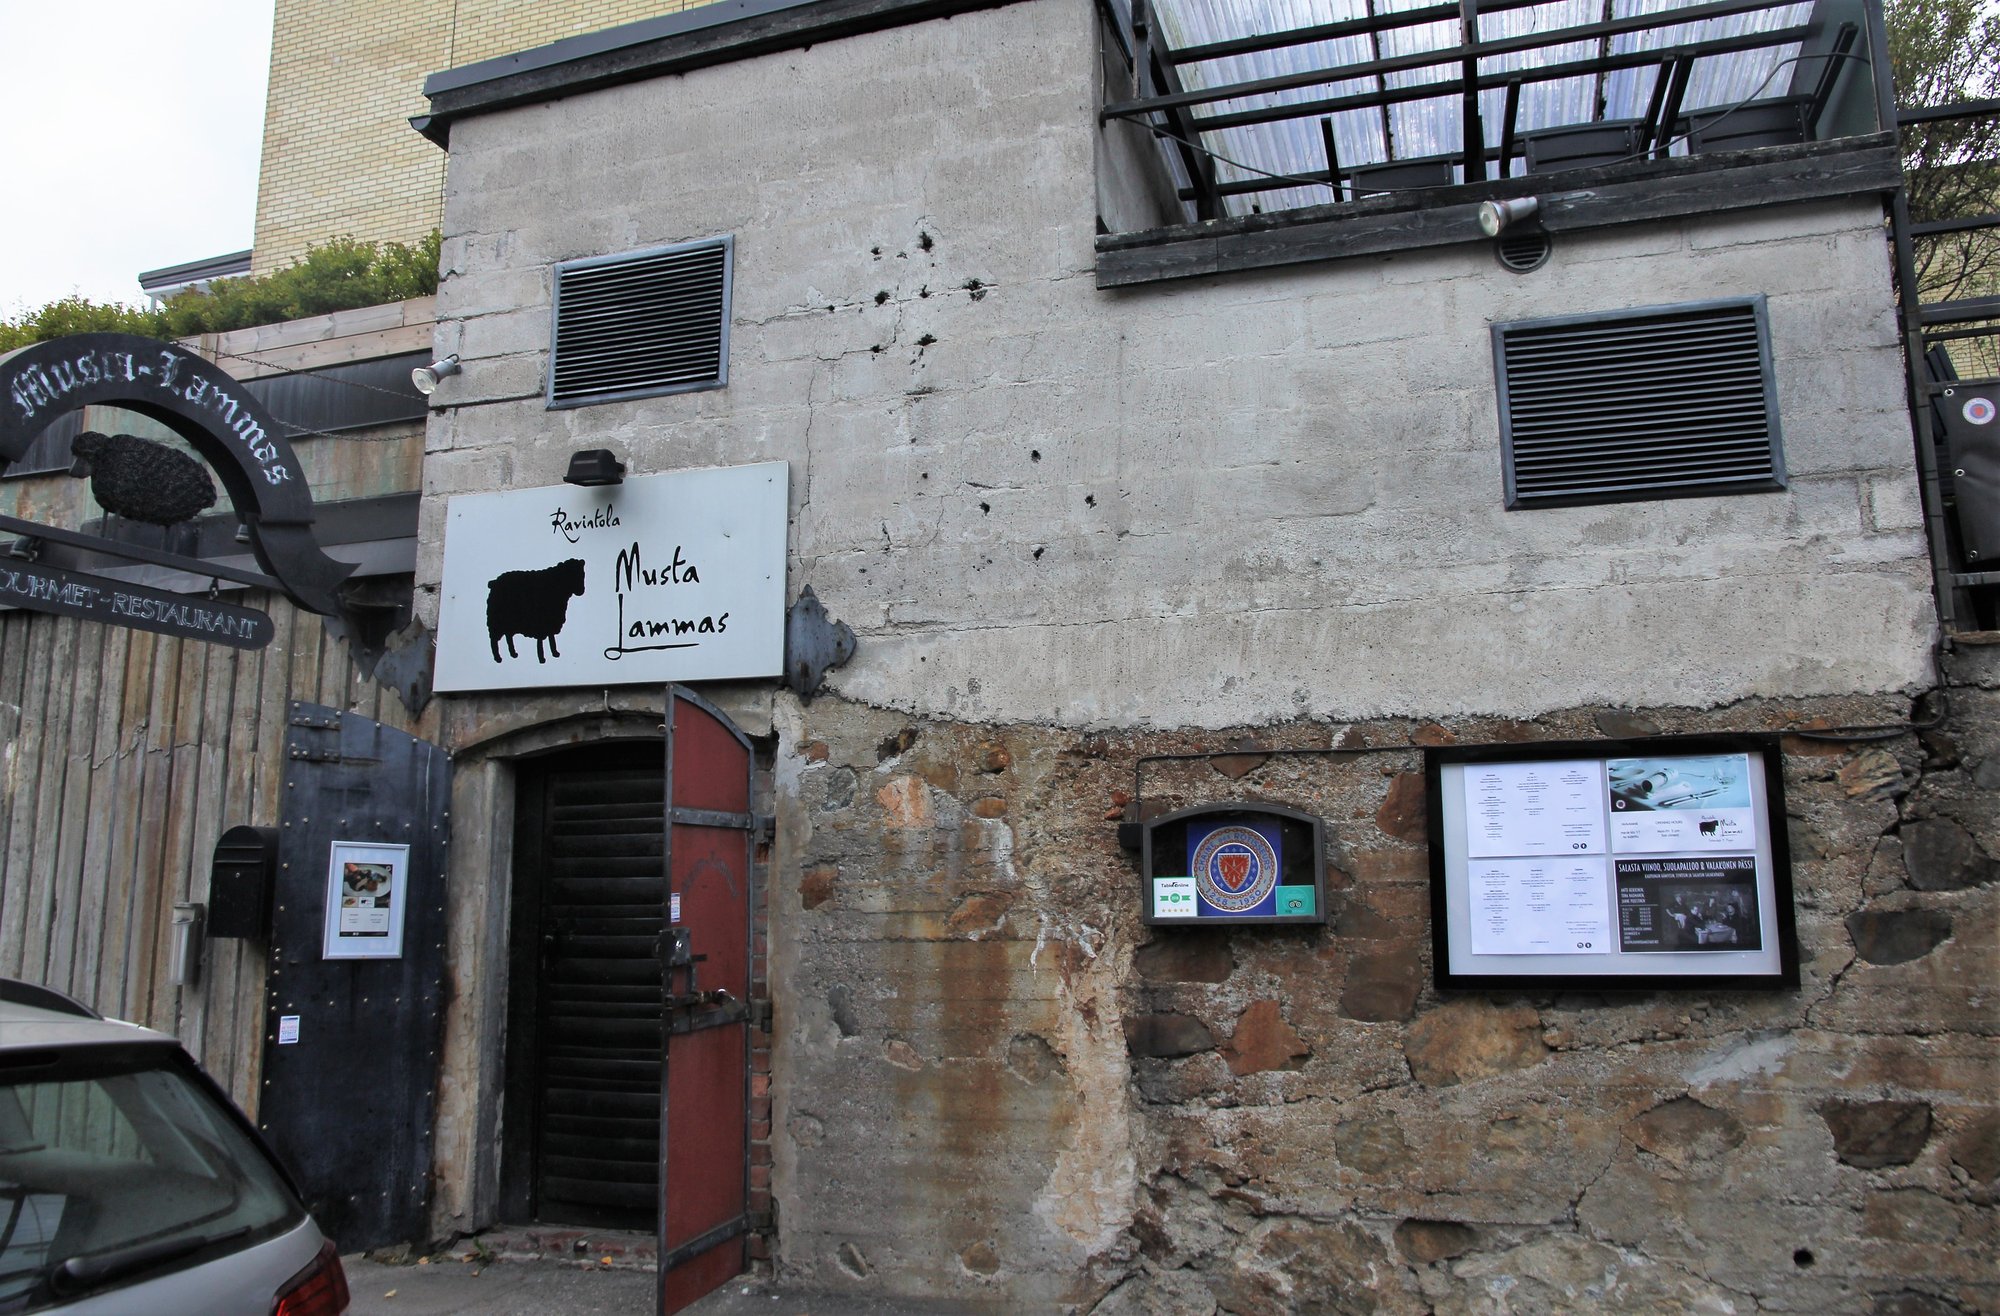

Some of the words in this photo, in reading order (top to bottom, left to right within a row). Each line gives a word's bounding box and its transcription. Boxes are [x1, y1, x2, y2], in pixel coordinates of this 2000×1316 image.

[550, 504, 621, 543] Ravintola
[615, 541, 700, 593] Musta
[604, 593, 729, 661] Lammas
[1618, 863, 1641, 873] SALASTA
[1737, 858, 1753, 869] PÄSSI
[1240, 890, 1262, 906] 1950
